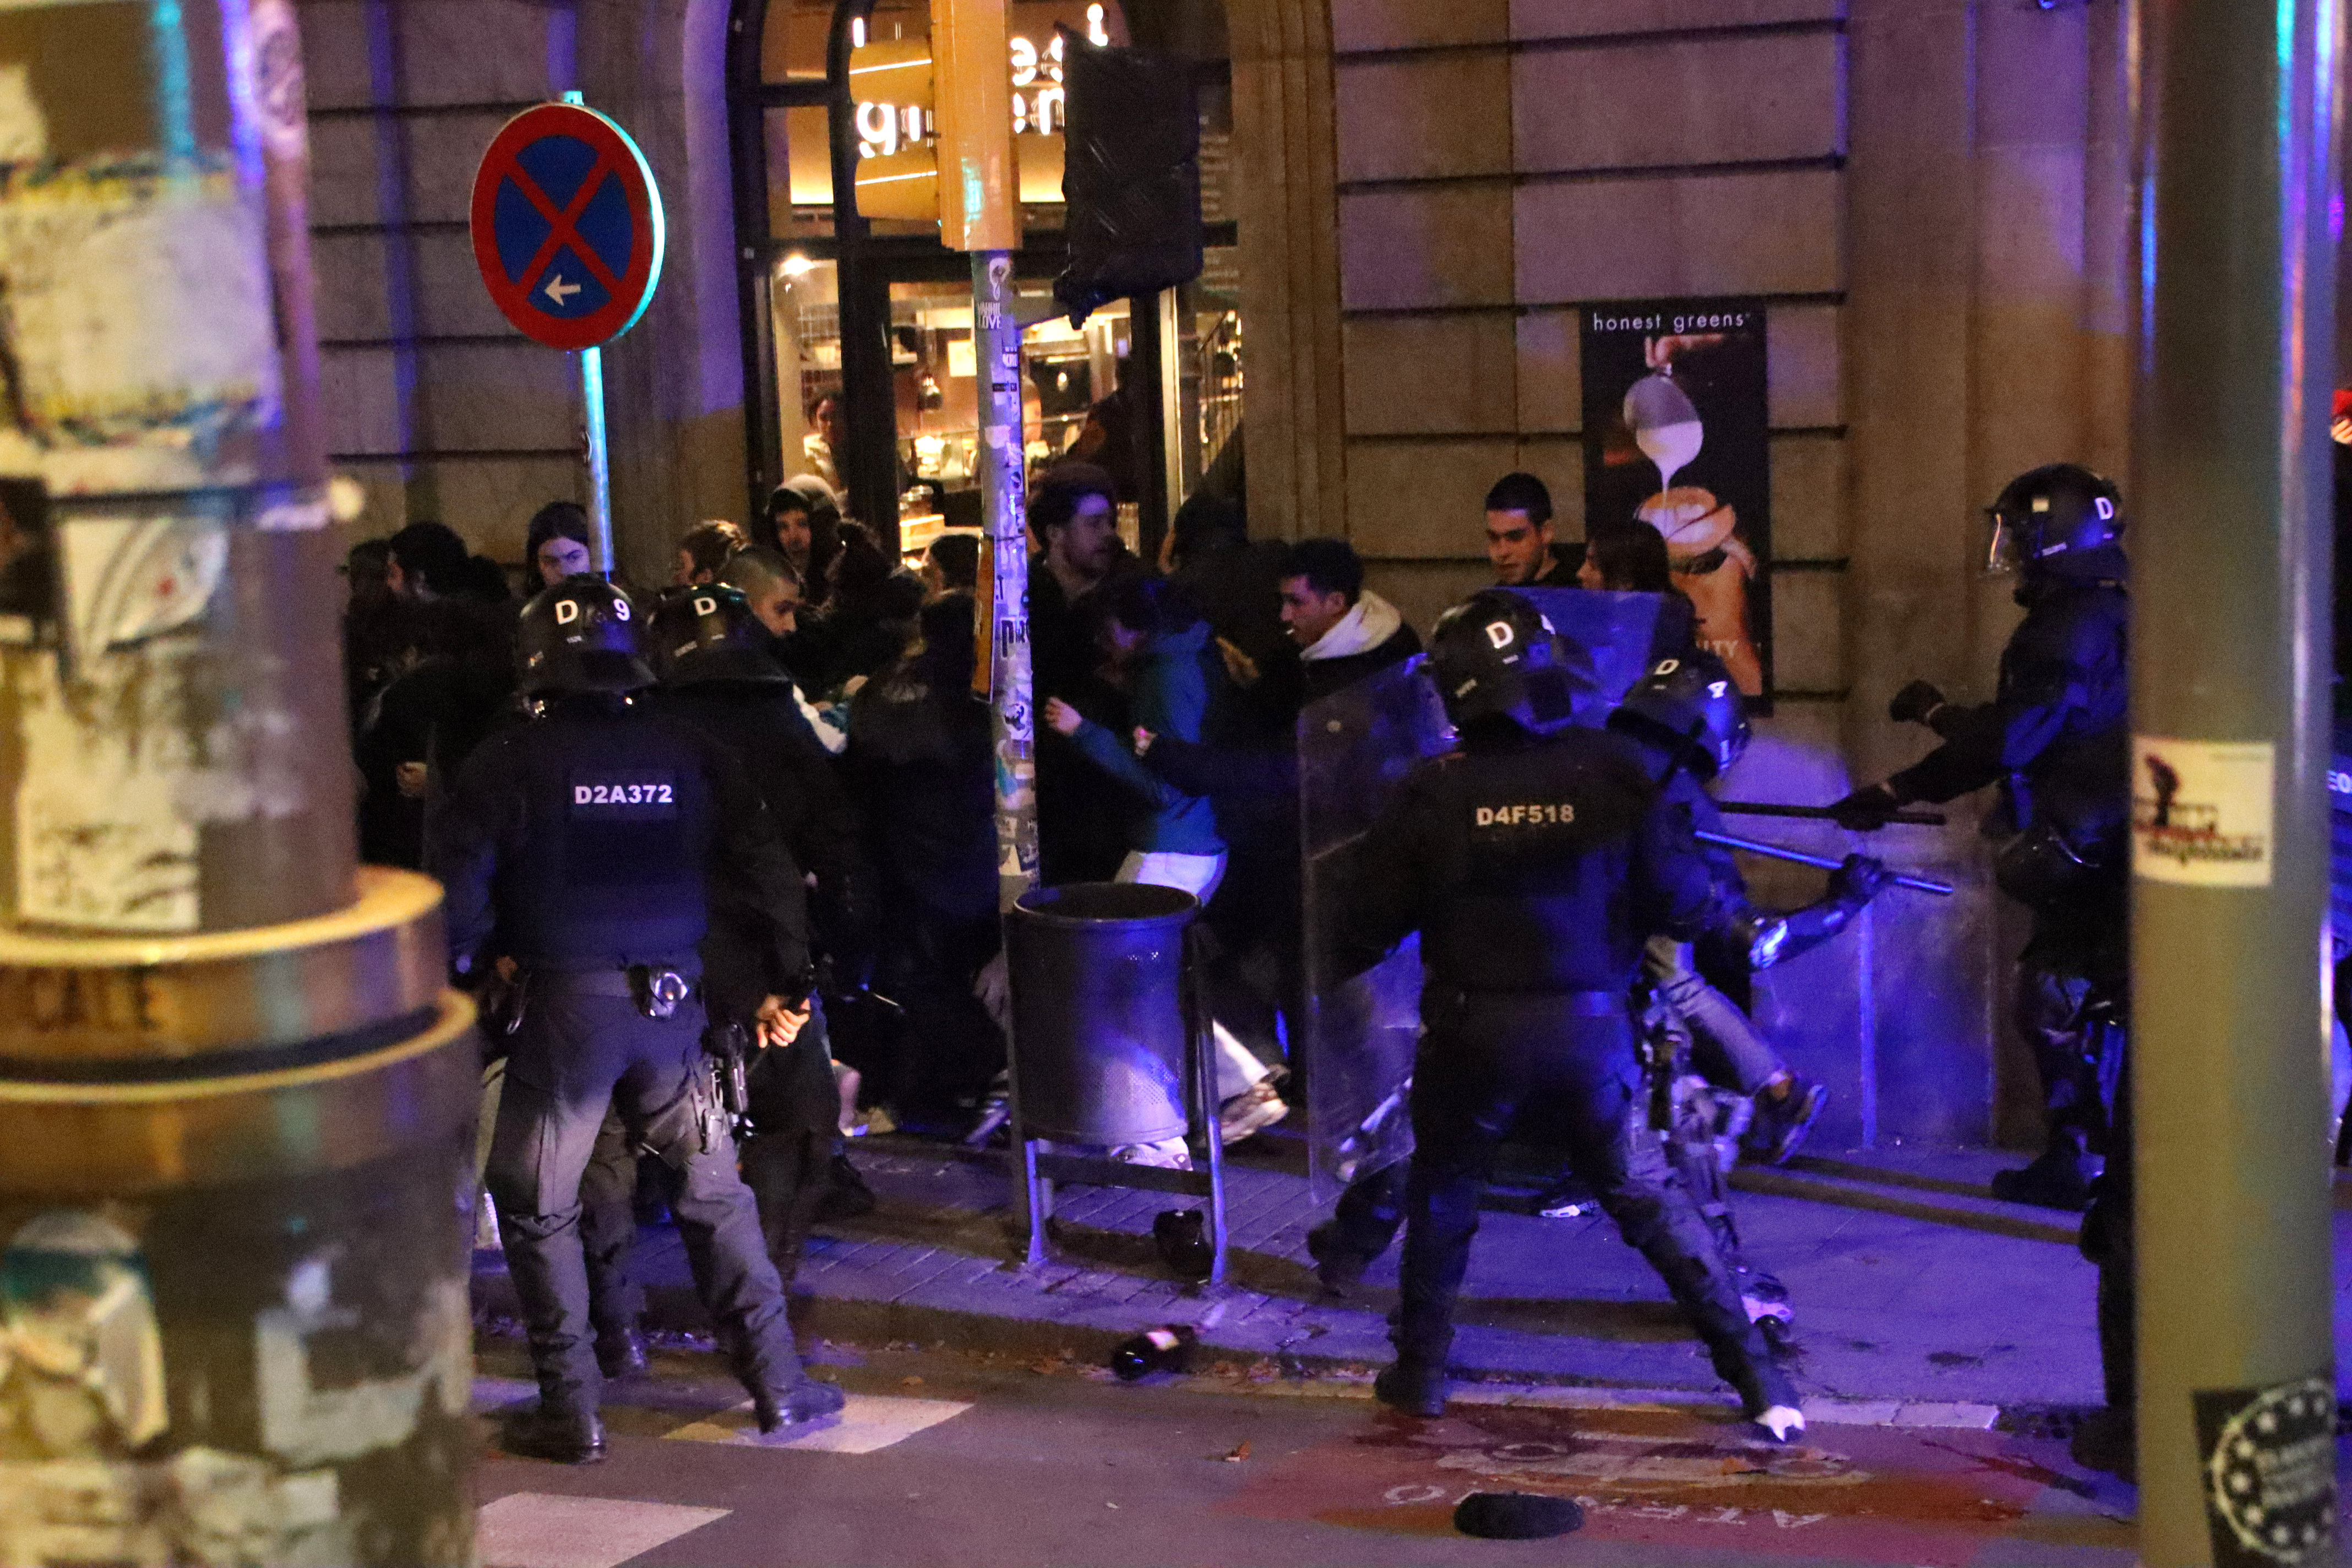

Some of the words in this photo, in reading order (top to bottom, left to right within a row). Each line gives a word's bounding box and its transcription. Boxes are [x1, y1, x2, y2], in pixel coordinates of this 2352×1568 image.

[1593, 313, 1661, 331] honest
[1674, 314, 1744, 334] greens
[2094, 497, 2114, 520] D
[556, 600, 579, 625] D
[613, 598, 631, 621] 9
[694, 597, 717, 616] D
[1485, 621, 1515, 649] D
[575, 785, 673, 804] D2A372
[1477, 804, 1575, 826] D4F518
